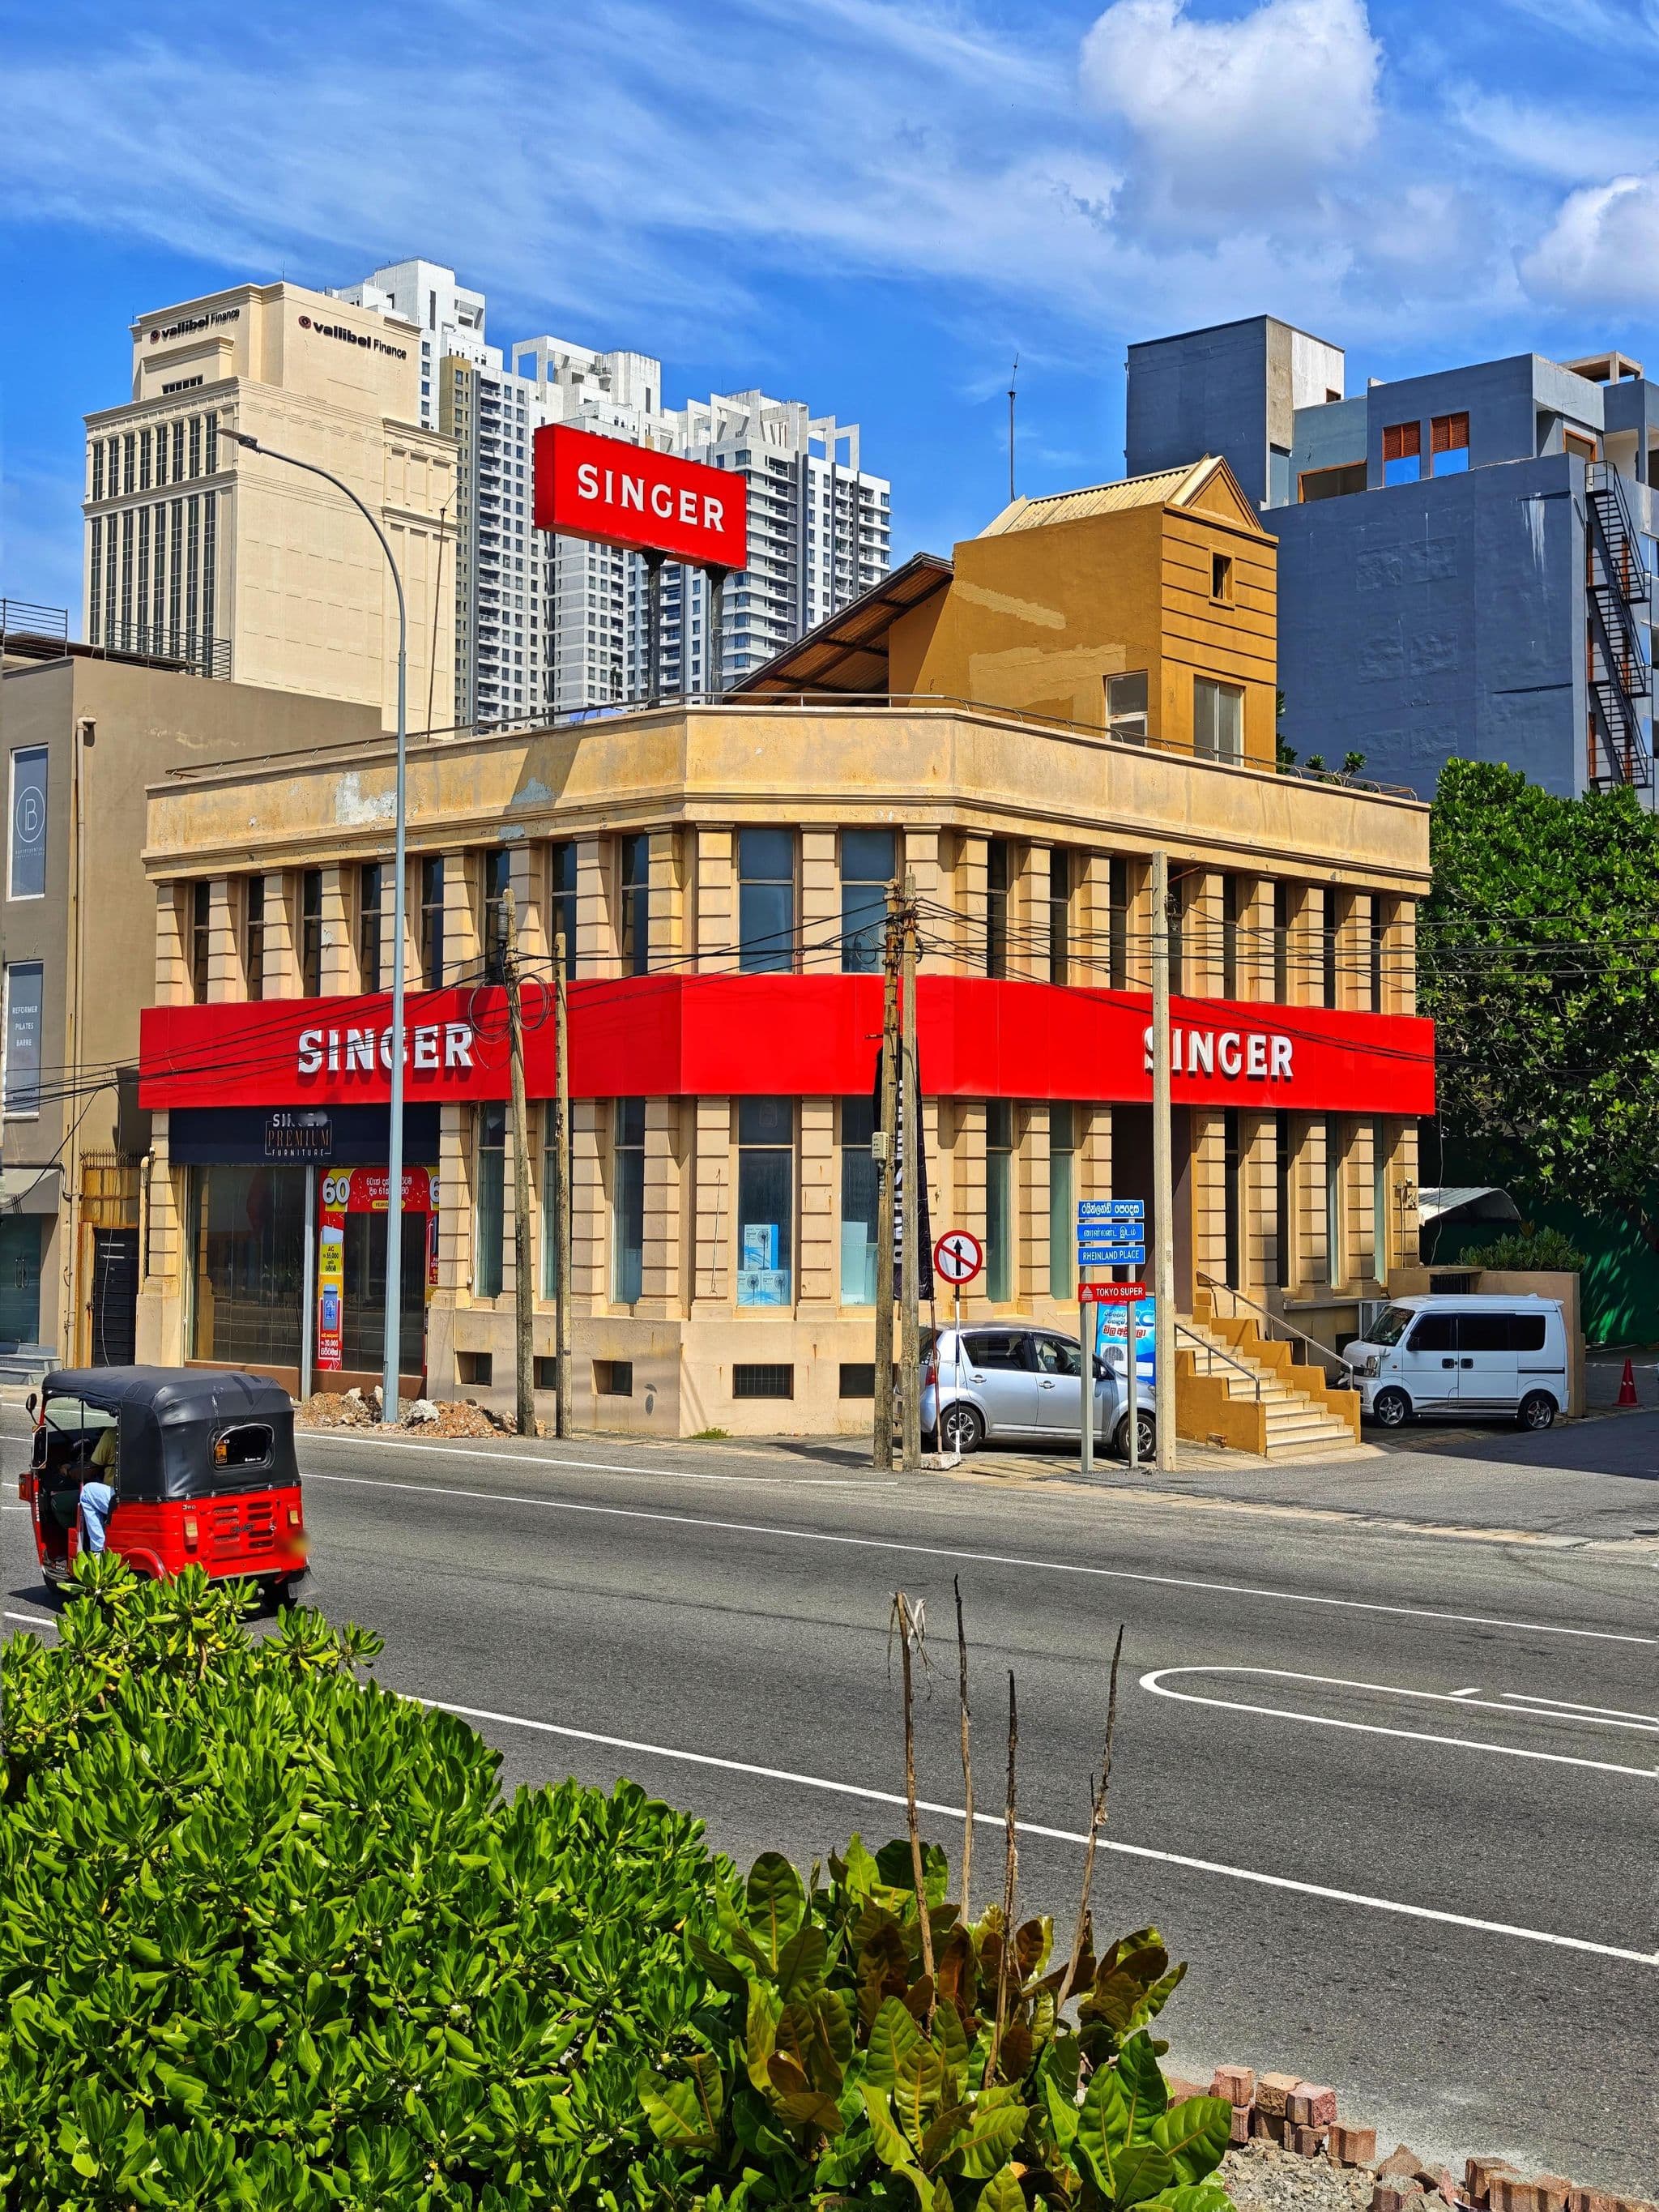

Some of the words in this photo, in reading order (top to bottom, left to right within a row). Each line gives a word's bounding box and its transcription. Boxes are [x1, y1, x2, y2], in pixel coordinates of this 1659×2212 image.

[162, 314, 209, 338] vallibel
[211, 309, 240, 325] Finance
[313, 322, 371, 349] vallibel
[373, 339, 407, 360] Finance
[578, 463, 725, 532] SINGER
[12, 1006, 38, 1014] REFORMER
[15, 1023, 34, 1031] PILATES
[16, 1039, 32, 1047] BARRE
[298, 1023, 474, 1074] SINGER
[268, 1129, 329, 1147] PREMIUM
[271, 1148, 324, 1156] FURNITURE
[322, 1176, 350, 1204] 60
[1082, 1250, 1118, 1261] RHEINLAND
[1120, 1249, 1140, 1259] PLACE
[1096, 1287, 1119, 1296] TOKYO
[1120, 1287, 1143, 1296] SUPER
